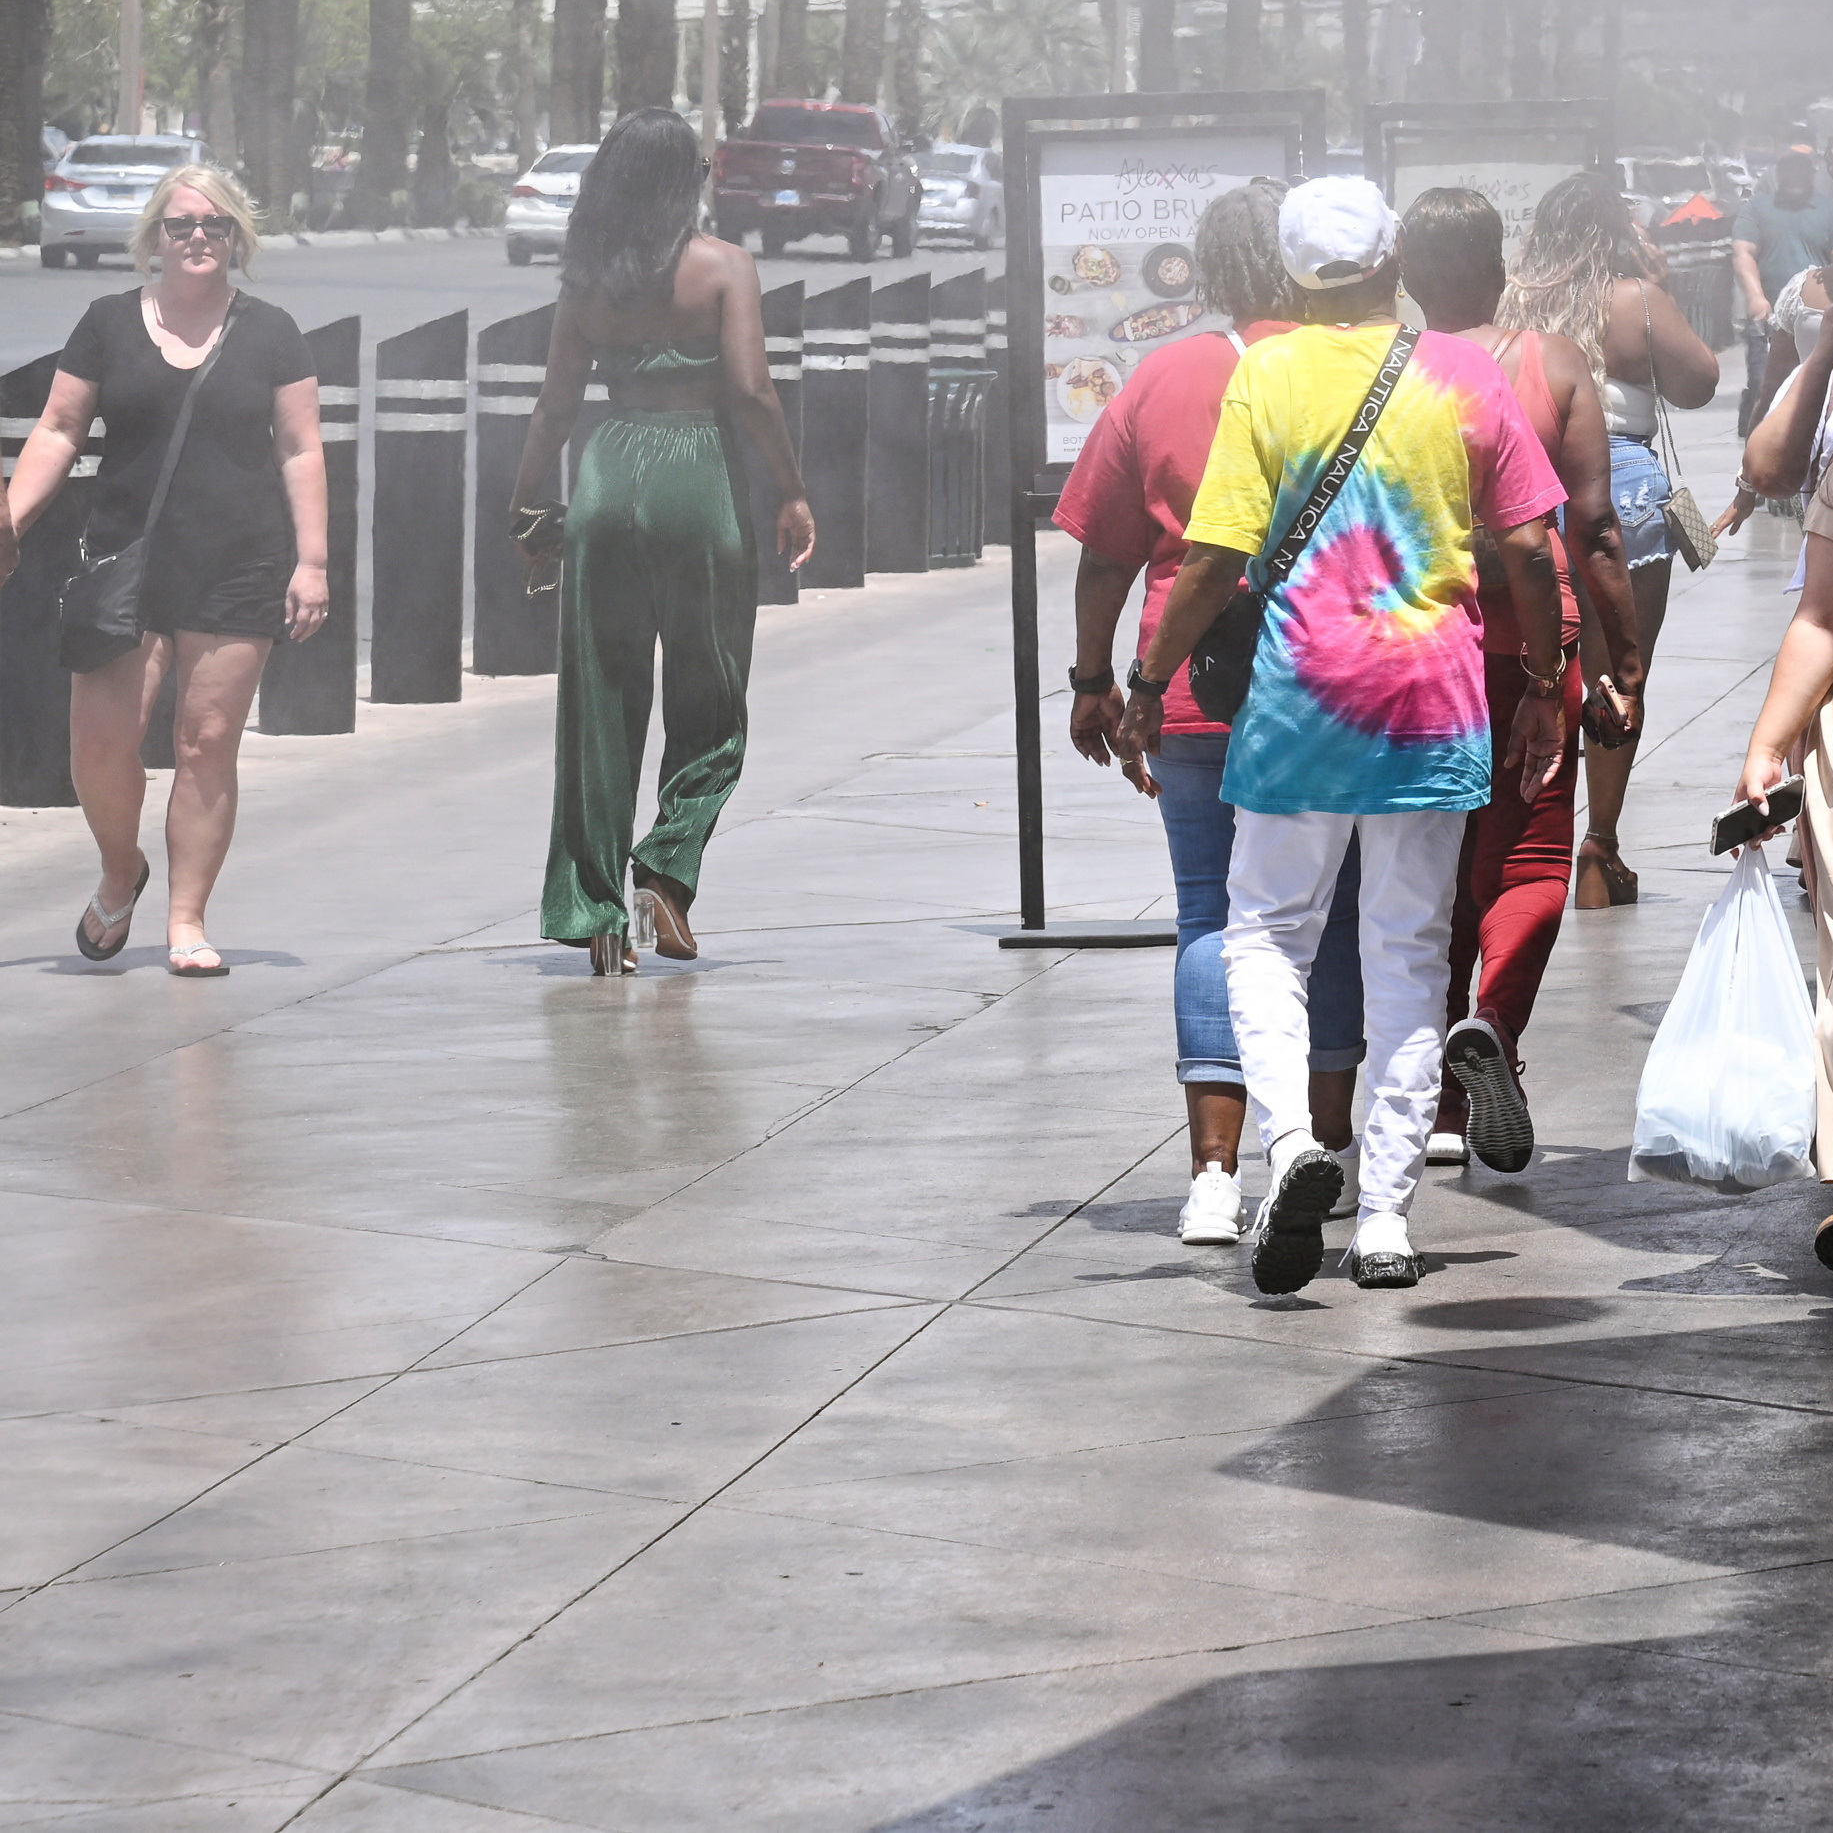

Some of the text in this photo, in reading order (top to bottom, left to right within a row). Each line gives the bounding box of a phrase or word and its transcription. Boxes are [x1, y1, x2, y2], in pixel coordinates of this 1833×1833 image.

[1060, 198, 1209, 223] PATIO BRU
[1088, 226, 1196, 241] NOW OPEN A
[1352, 339, 1412, 433] NAUTICA
[1289, 443, 1358, 541] NAUTICA
